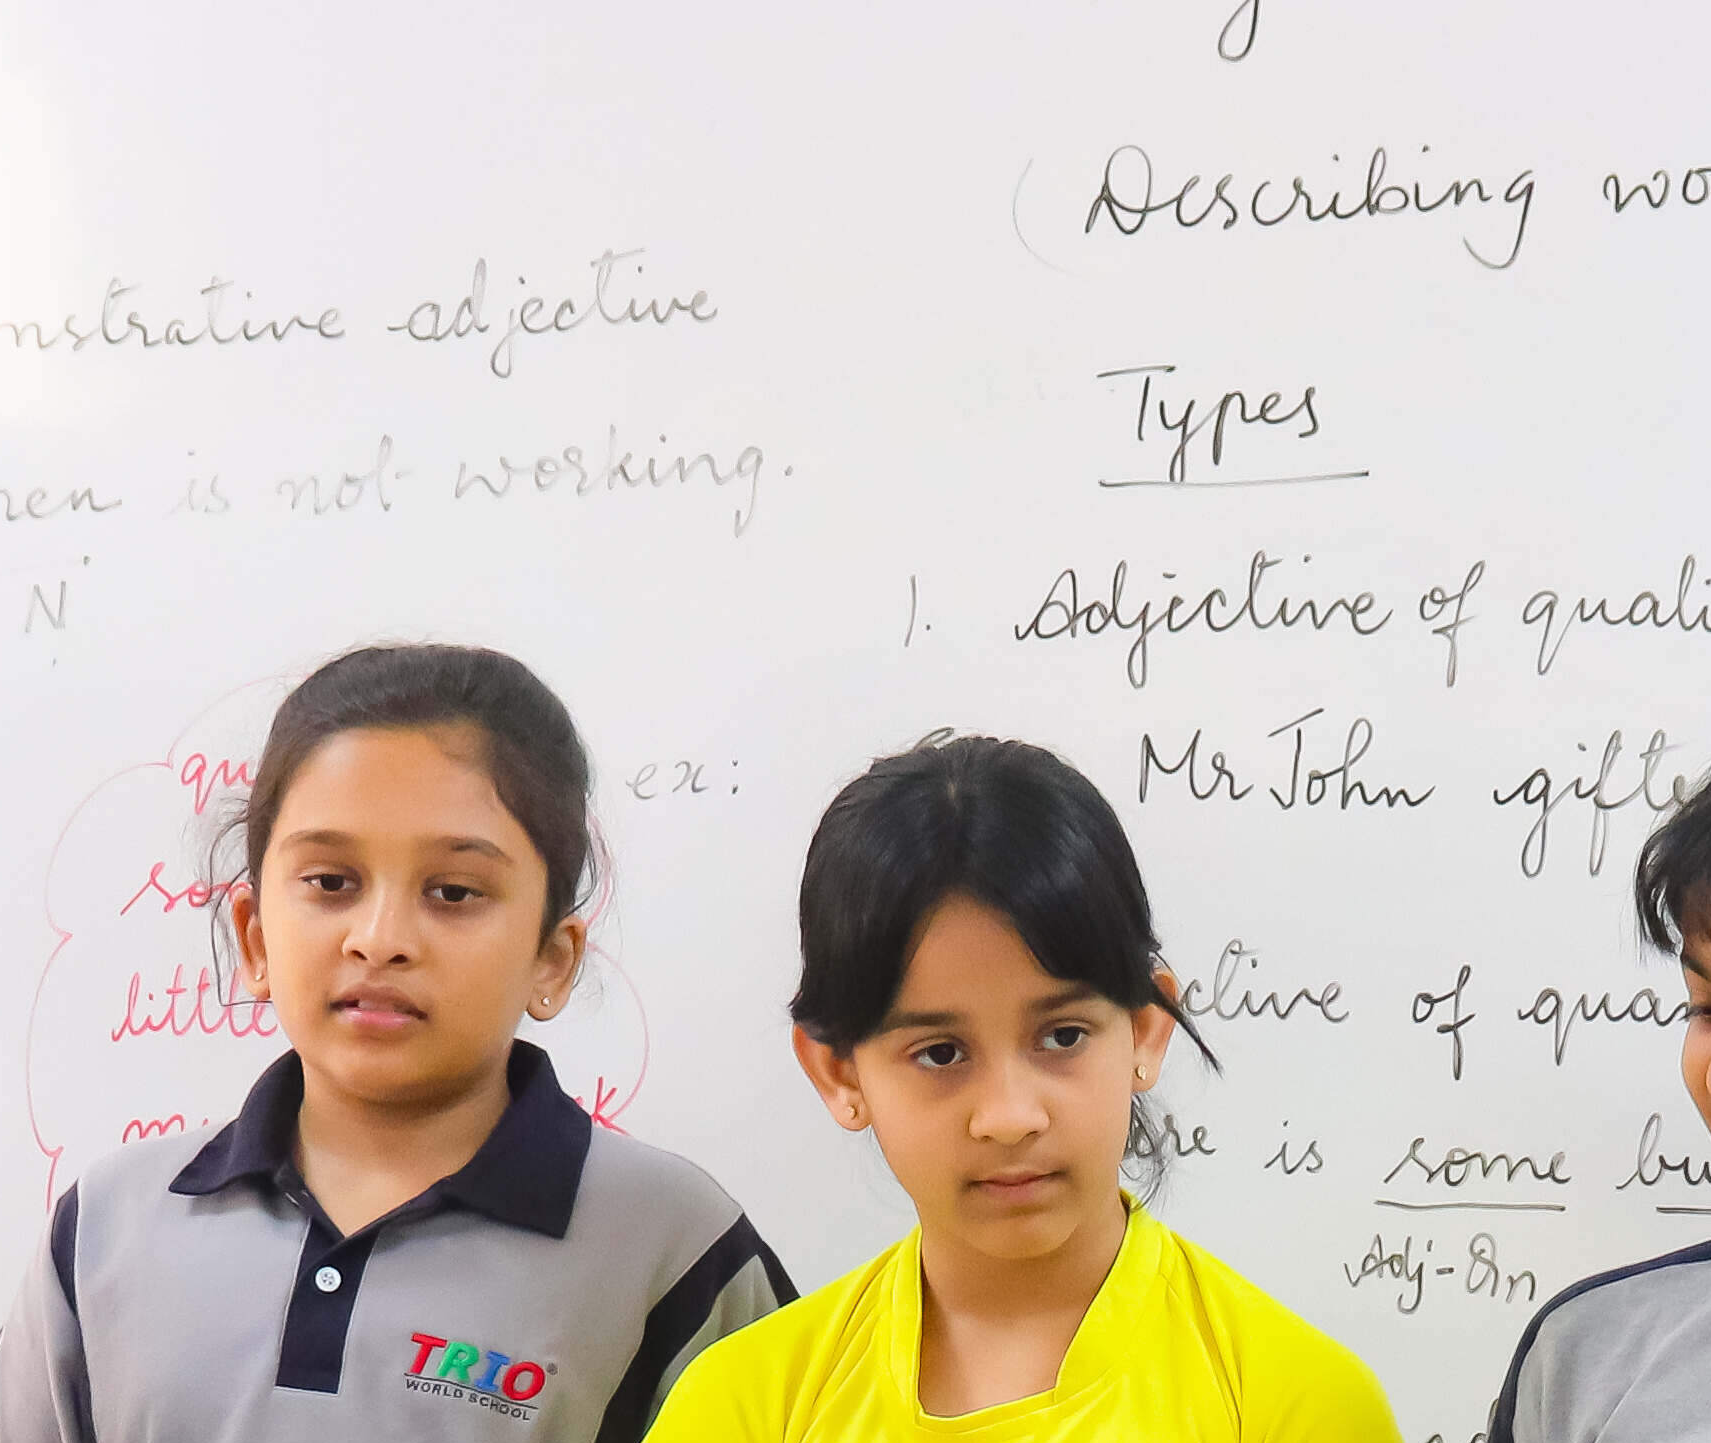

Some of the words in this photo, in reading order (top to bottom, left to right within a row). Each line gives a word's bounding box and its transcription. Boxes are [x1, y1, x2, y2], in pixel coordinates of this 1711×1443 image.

[1084, 144, 1533, 270] Describing
[387, 247, 718, 378] adjective
[276, 433, 417, 515] not
[1096, 364, 1318, 484] Types
[1014, 549, 1393, 689] Adjective
[1418, 559, 1486, 688] of
[1139, 731, 1255, 804] Mr
[1267, 707, 1435, 811] John
[1493, 728, 1690, 878] gifte
[1411, 964, 1477, 1081] of
[1263, 1120, 1324, 1175] is
[1382, 1136, 1572, 1185] some
[405, 1378, 464, 1399] WORLD
[468, 1392, 531, 1421] SCHOOL
[410, 1331, 546, 1401] TRIO
